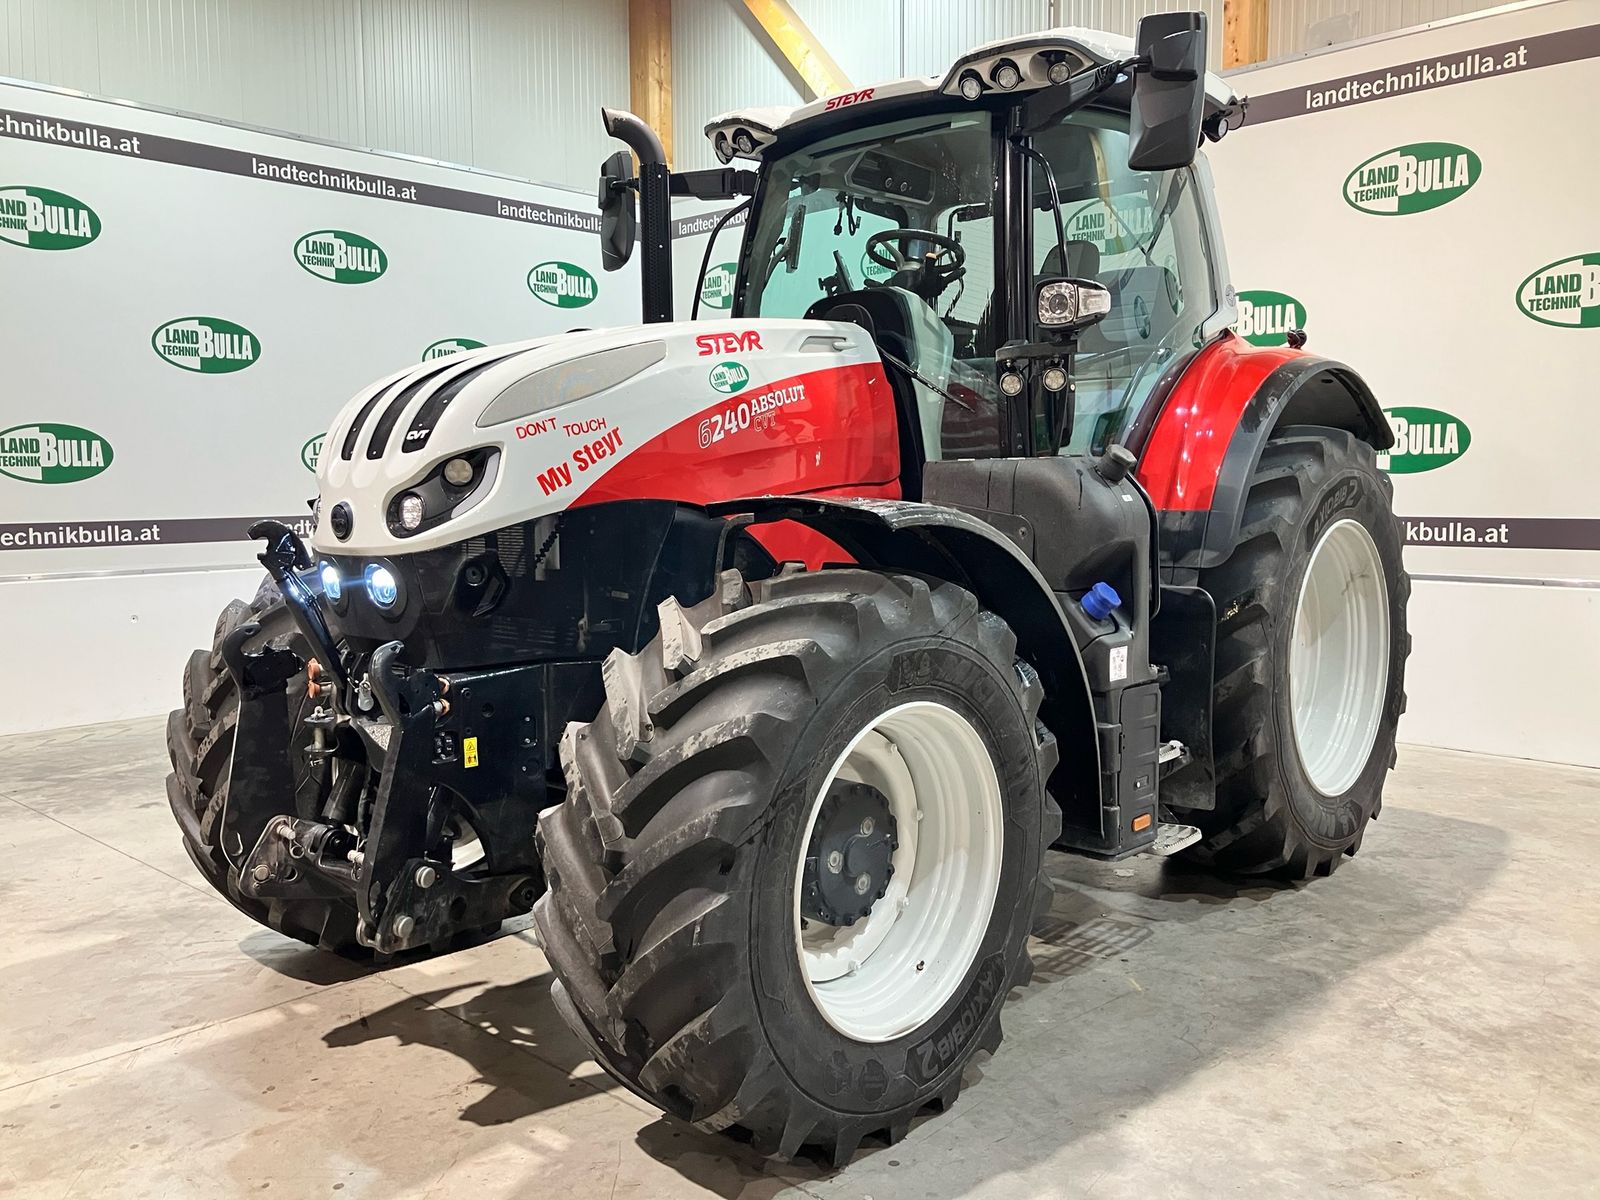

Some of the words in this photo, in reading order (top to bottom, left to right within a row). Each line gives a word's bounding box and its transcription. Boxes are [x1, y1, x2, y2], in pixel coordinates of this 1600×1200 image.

[1306, 46, 1527, 109] landtechnikbulla.at
[825, 88, 874, 111] STEYR
[252, 158, 417, 201] landtechnikbulla.at
[1359, 165, 1399, 188] LAND
[1400, 154, 1470, 197] BULLA
[1354, 185, 1399, 203] TECHNIK
[26, 195, 92, 238] BULLA
[1076, 212, 1105, 231] LAND
[305, 240, 335, 256] LAND
[334, 238, 381, 273] BULLA
[302, 254, 335, 268] TECHNIK
[533, 283, 558, 295] TECHNIK
[535, 270, 558, 285] LAND
[557, 268, 593, 299] BULLA
[704, 275, 722, 290] LAND
[1535, 273, 1582, 296] LAND
[1528, 295, 1581, 312] TECHNIK
[1238, 300, 1297, 337] BULLA
[165, 328, 199, 345] LAND
[198, 324, 253, 361] BULLA
[695, 330, 763, 356] STEYR
[161, 344, 200, 357] TECHNIK
[712, 371, 727, 381] LAND
[563, 418, 607, 437] TOUCH
[698, 402, 750, 449] 6240
[751, 385, 805, 416] ABSOLUT
[753, 410, 776, 432] CVT
[0, 438, 41, 454] LAND
[406, 429, 430, 440] CVT
[1392, 417, 1459, 456] BULLA
[40, 432, 105, 467] BULLA
[536, 462, 573, 497] My
[0, 524, 160, 547] echnikbulla.at
